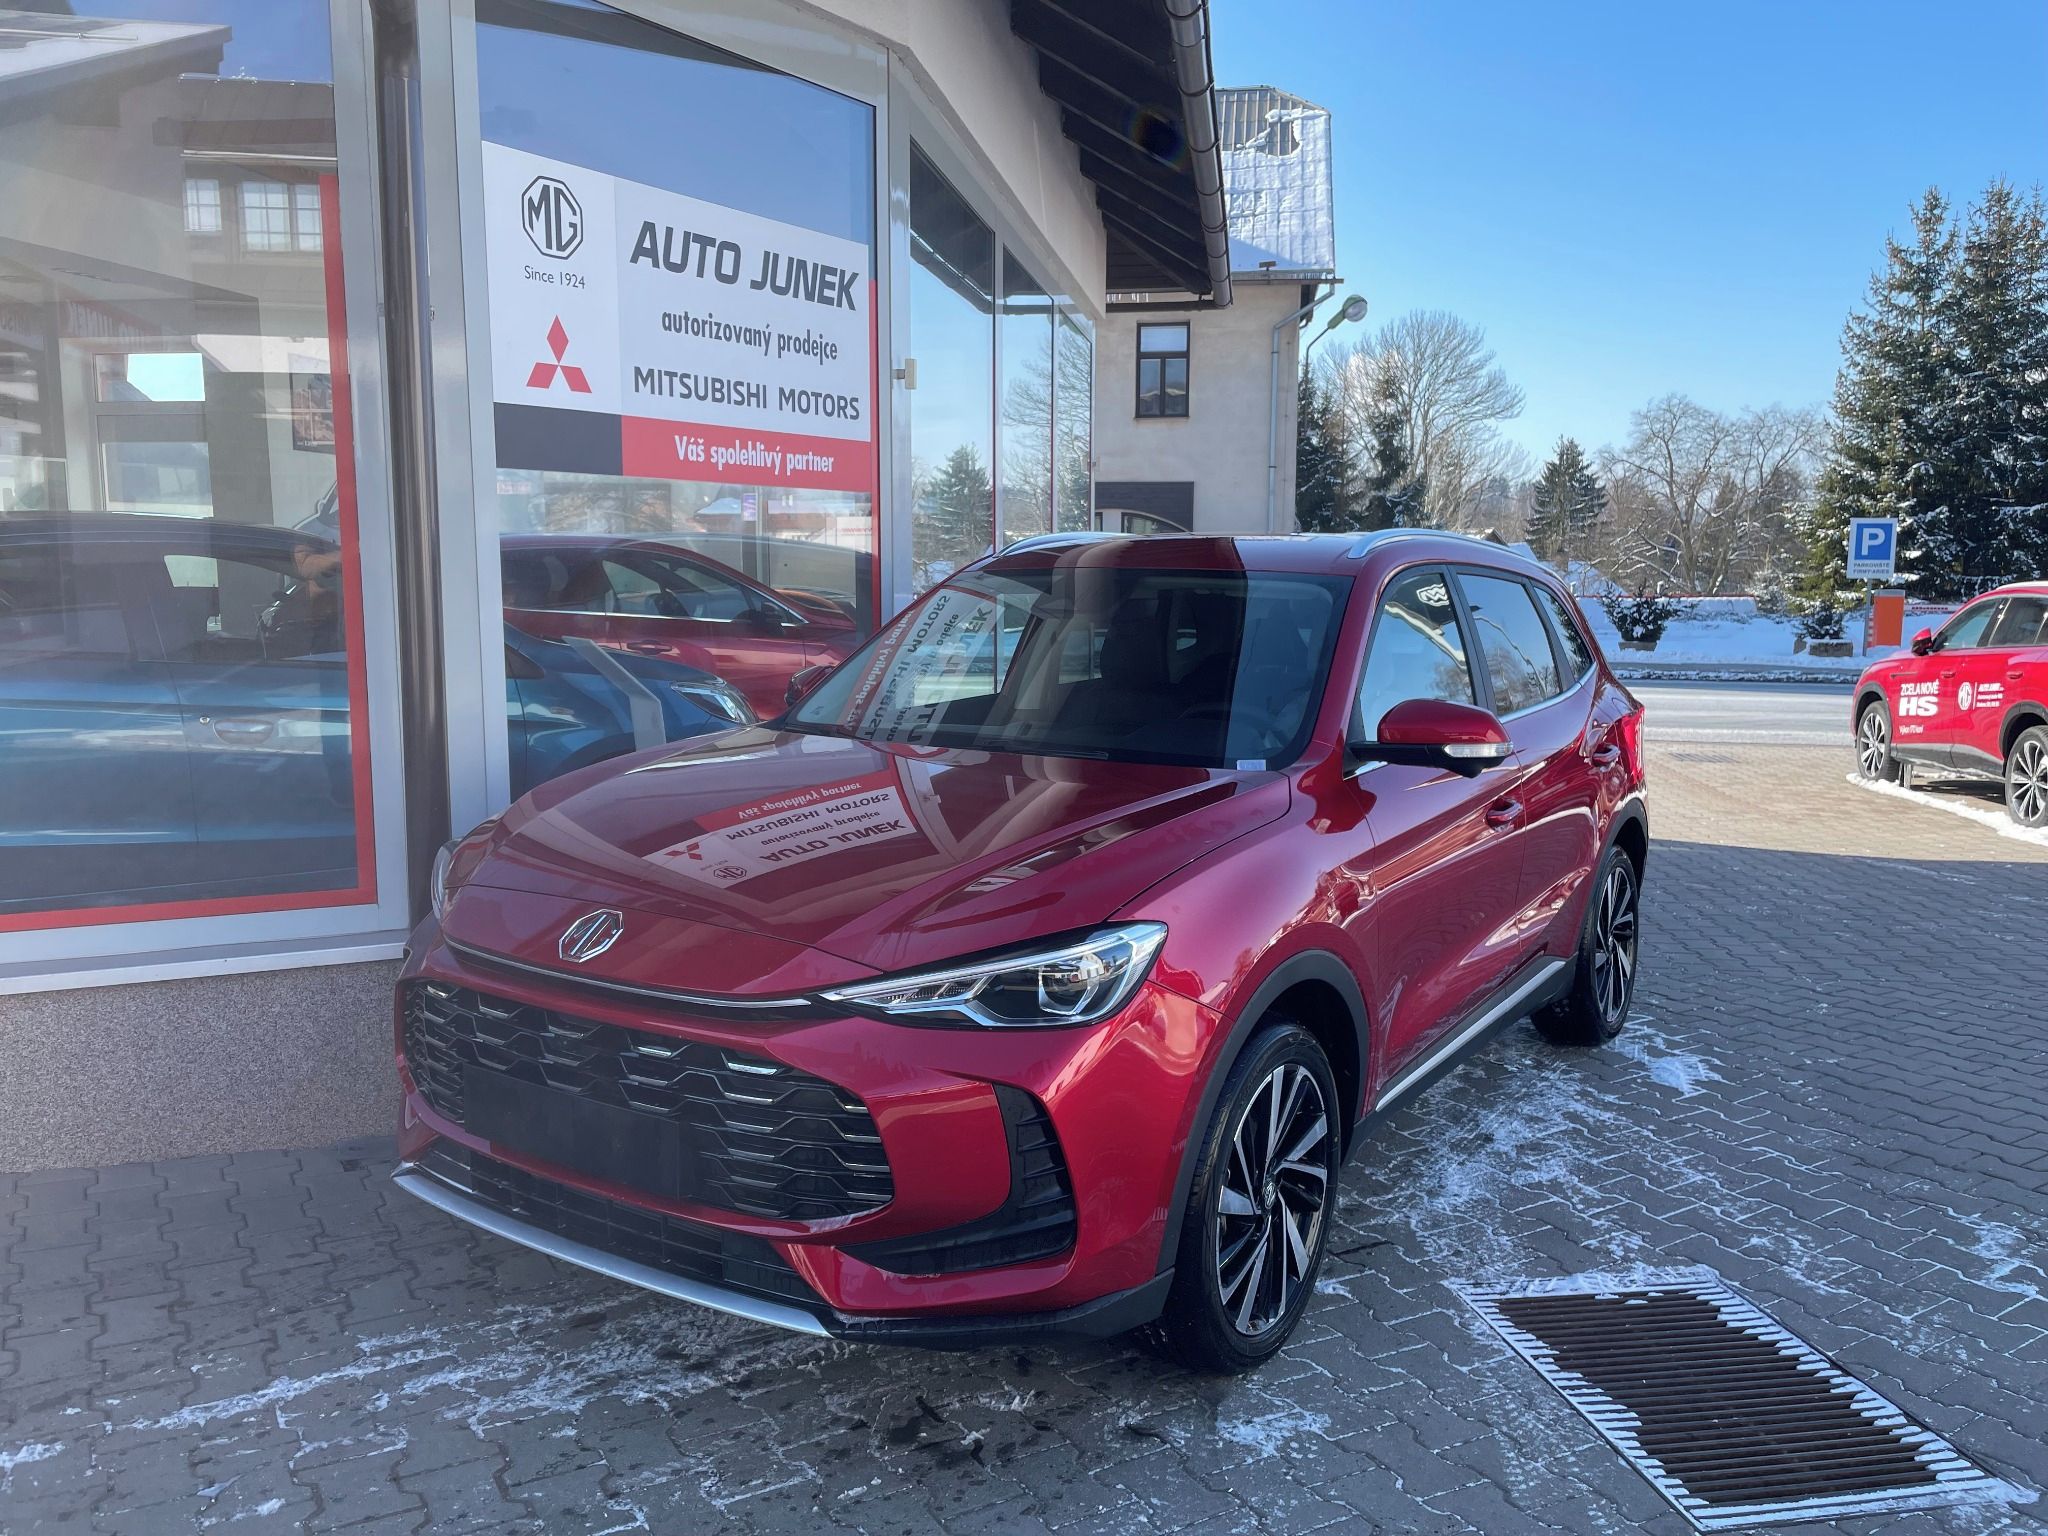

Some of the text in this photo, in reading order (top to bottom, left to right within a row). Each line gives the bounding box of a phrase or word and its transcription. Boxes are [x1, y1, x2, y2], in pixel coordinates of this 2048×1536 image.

[524, 179, 581, 256] MG
[524, 266, 586, 290] Since 1924
[629, 220, 859, 311] AUTO JUNEK
[661, 311, 838, 366] autorizovaný prodejce
[634, 366, 860, 421] MITSUBISHI MOTORS
[674, 435, 835, 476] Váš spolehlivý partner
[1861, 527, 1886, 556] P
[1899, 696, 1938, 717] HS
[559, 909, 623, 962] MG
